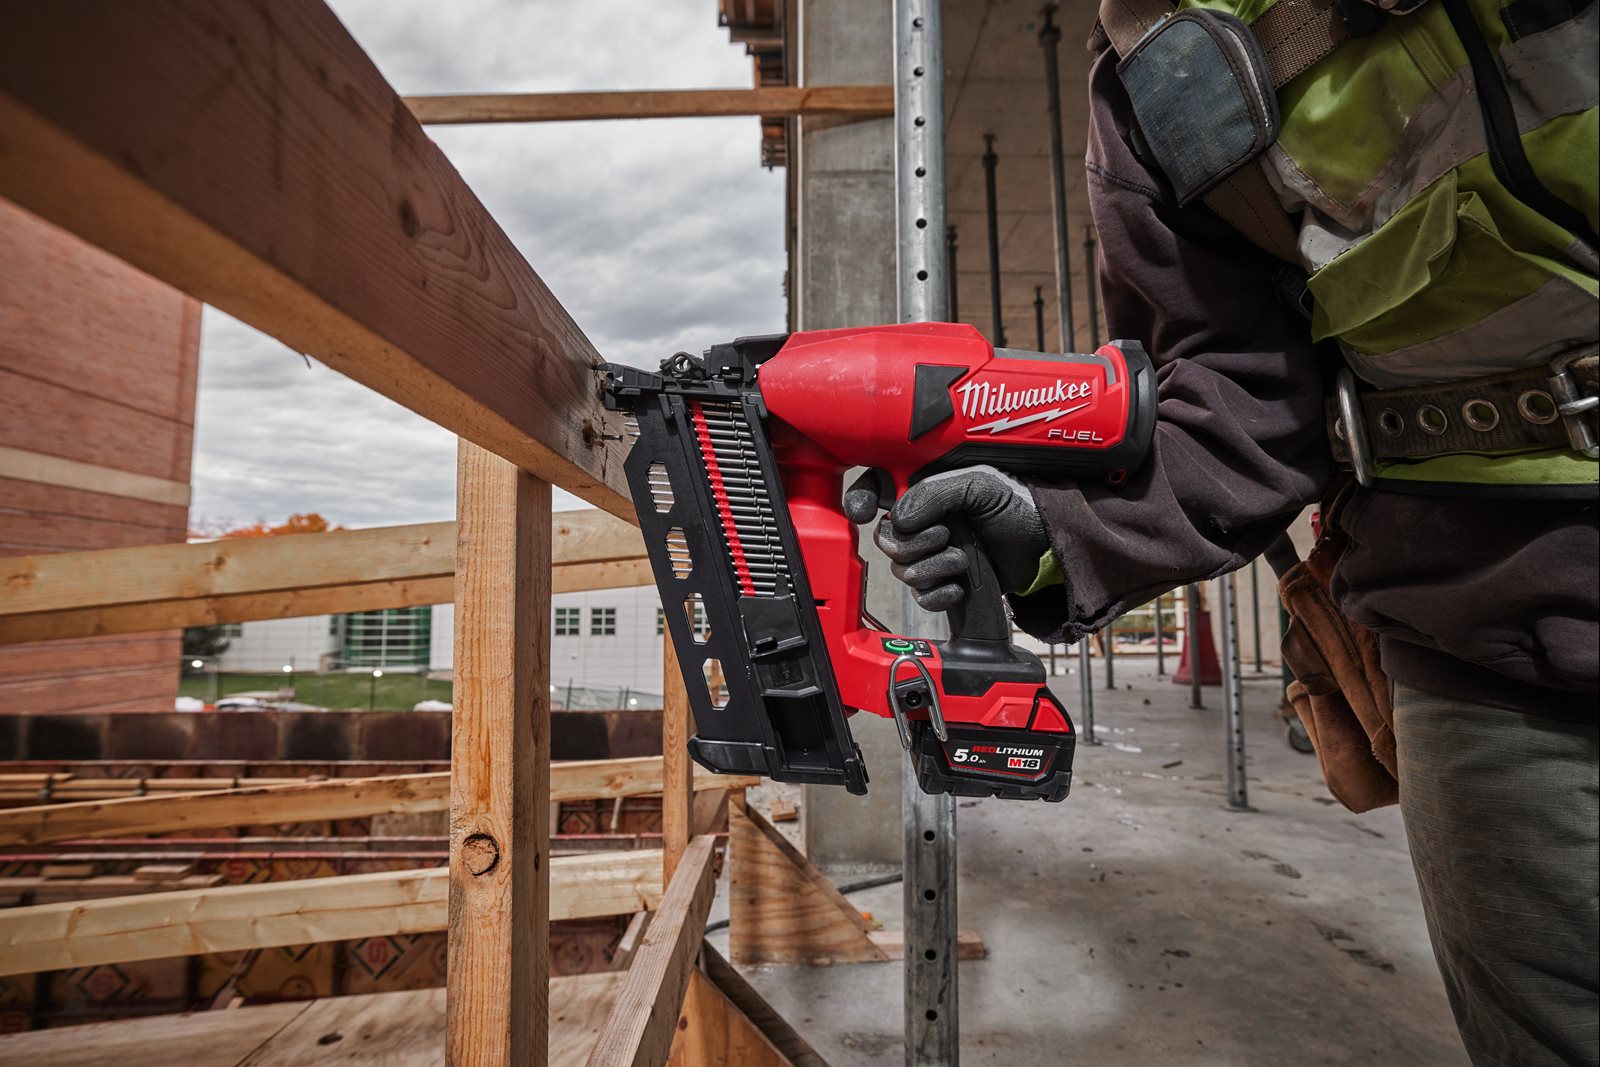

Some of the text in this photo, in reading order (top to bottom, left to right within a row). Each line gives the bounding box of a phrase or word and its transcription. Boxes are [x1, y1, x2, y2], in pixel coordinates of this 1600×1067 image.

[957, 380, 1091, 418] Milwaukee
[1048, 429, 1103, 440] FUEL
[953, 749, 978, 762] 5.0
[972, 746, 1043, 756] REDLITHIUM
[1008, 758, 1039, 768] M18
